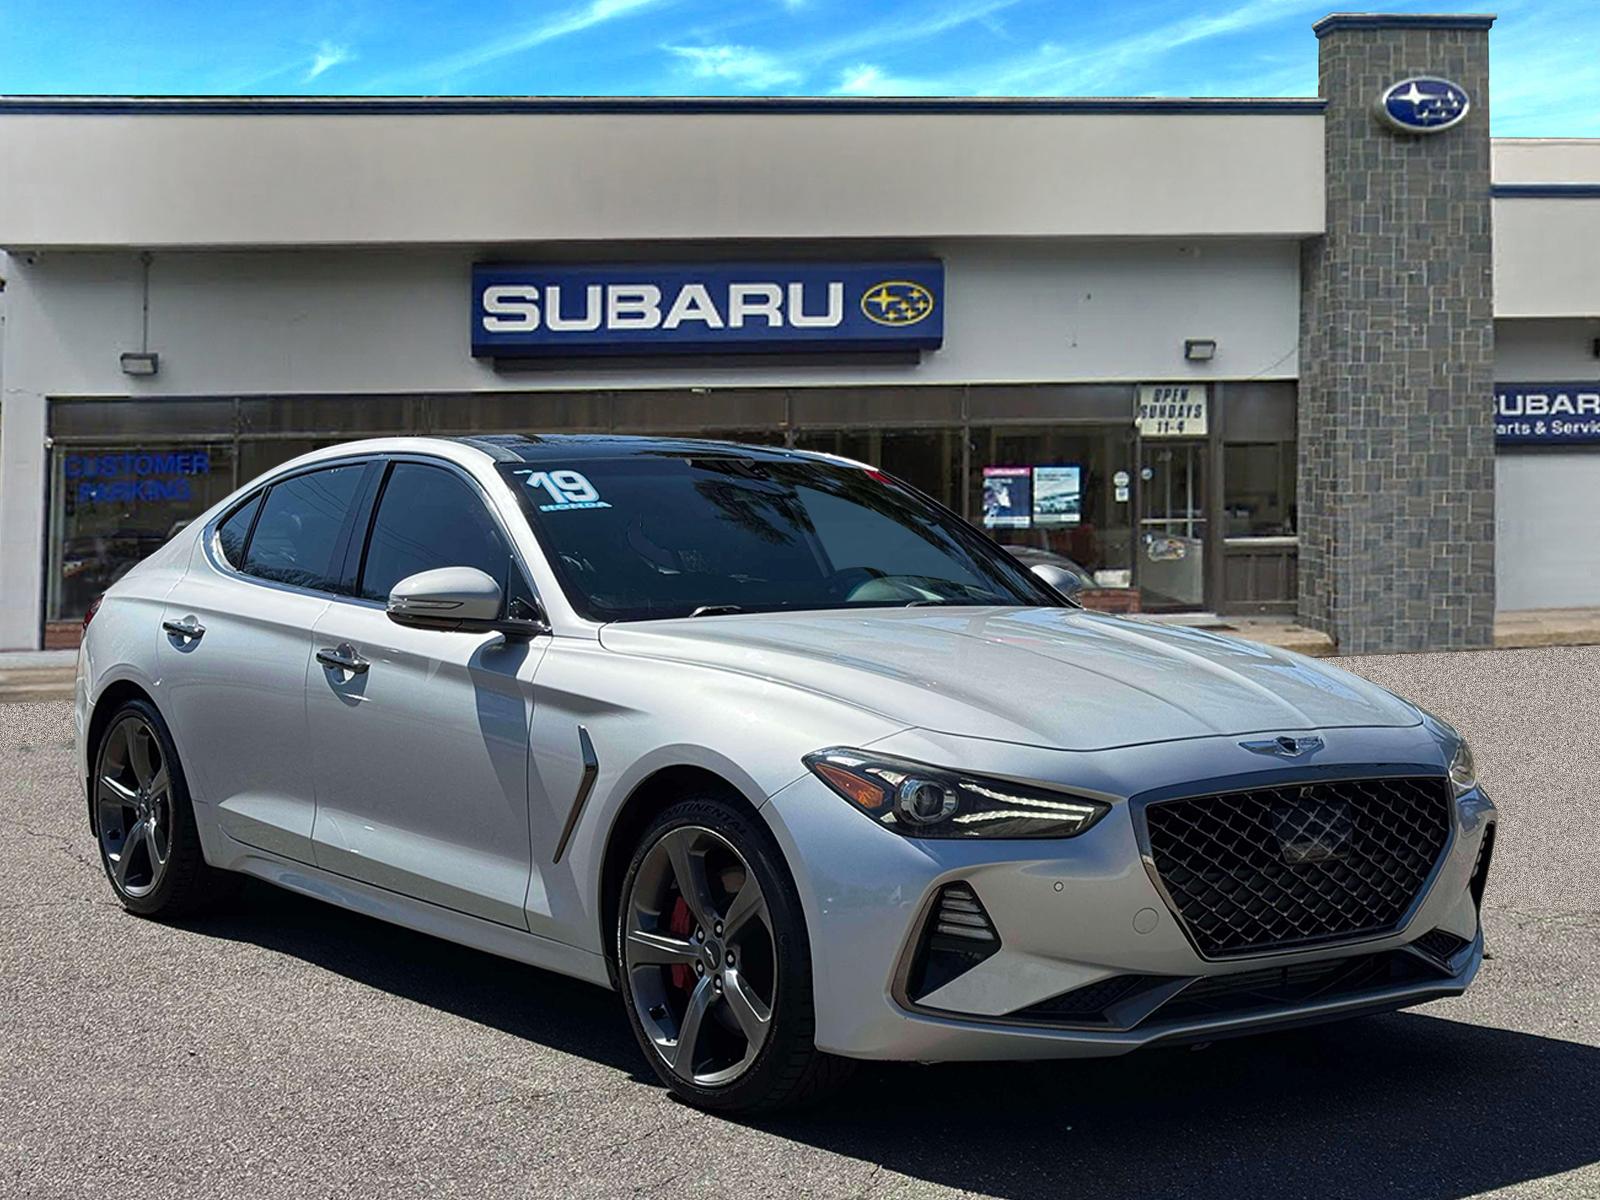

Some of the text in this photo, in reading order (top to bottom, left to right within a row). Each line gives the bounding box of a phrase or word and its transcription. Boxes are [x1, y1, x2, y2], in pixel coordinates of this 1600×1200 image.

[482, 281, 844, 332] SUBARU
[1153, 388, 1189, 403] OPEN
[1493, 394, 1600, 415] UBAR
[1140, 404, 1202, 419] SUNDAYS
[1493, 422, 1530, 435] arts
[1534, 421, 1546, 435] &
[64, 451, 209, 478] CUSTOMER
[77, 479, 192, 502] PARKING
